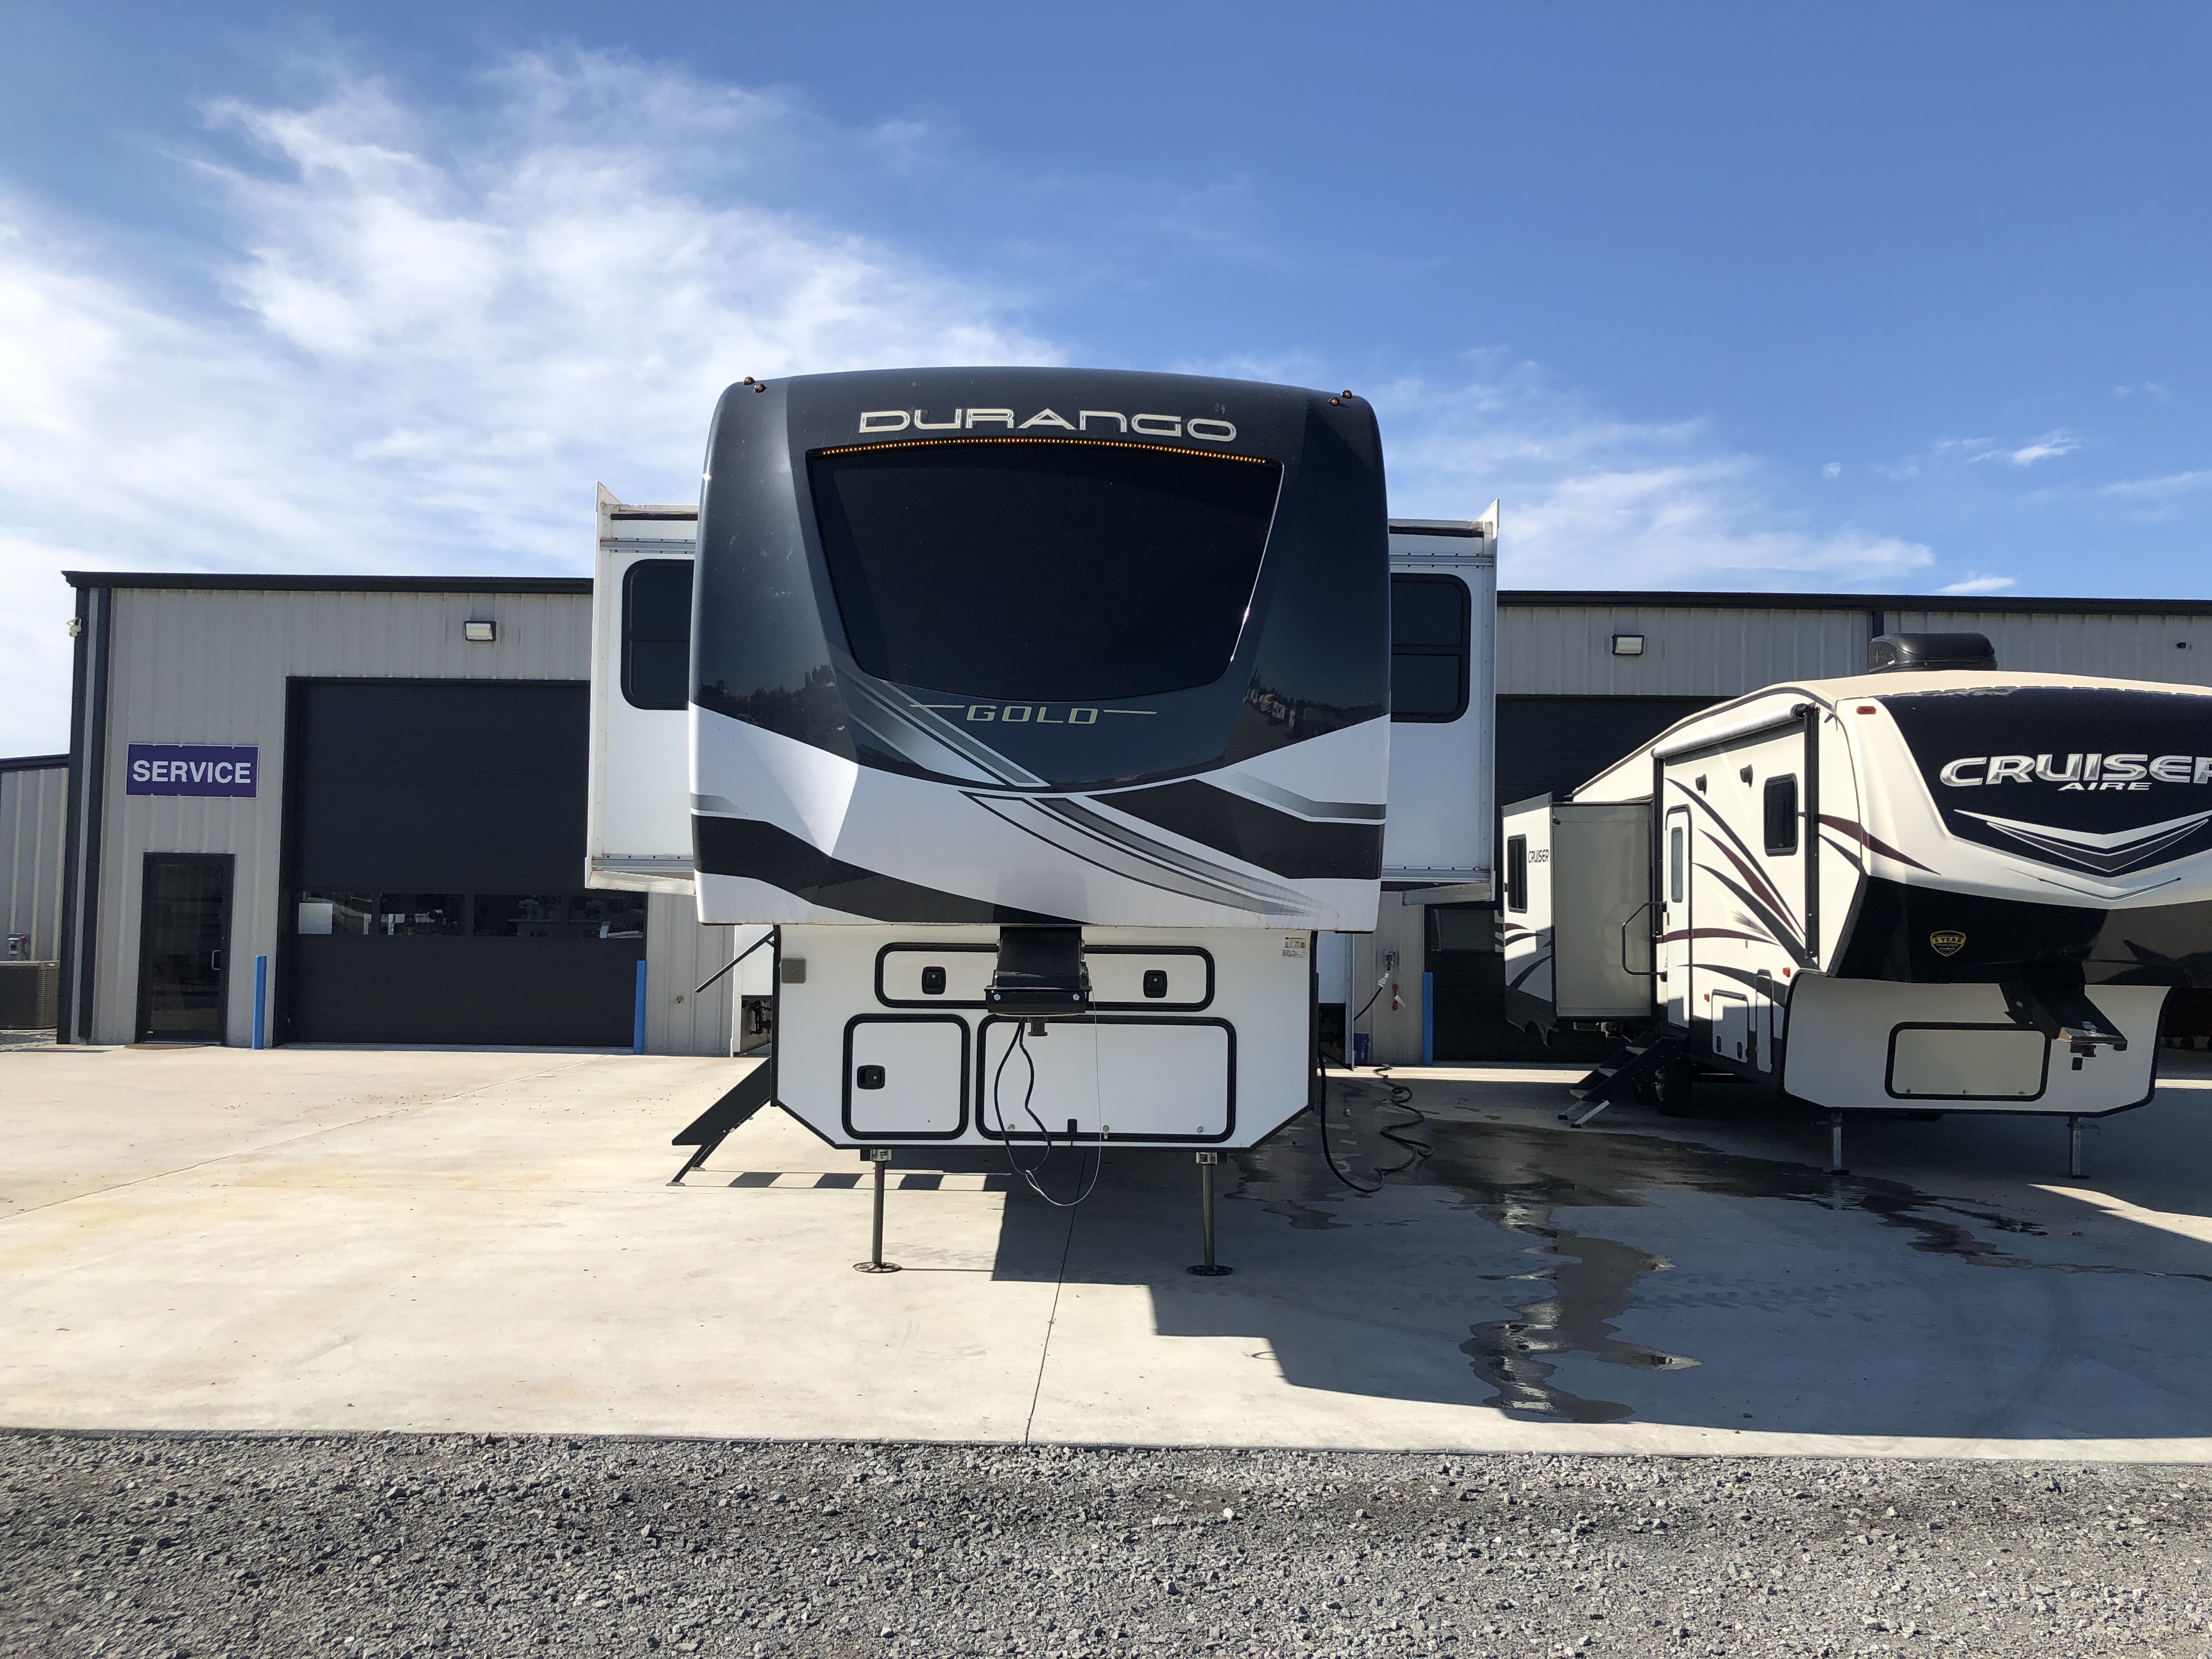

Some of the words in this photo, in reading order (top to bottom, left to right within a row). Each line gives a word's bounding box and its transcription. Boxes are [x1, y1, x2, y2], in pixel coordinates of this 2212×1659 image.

[858, 408, 1238, 442] DURANGO
[966, 705, 1099, 724] GOLD
[132, 760, 252, 784] SERVICE
[2057, 782, 2153, 791] AIRE
[1528, 849, 1549, 863] CRUISER
